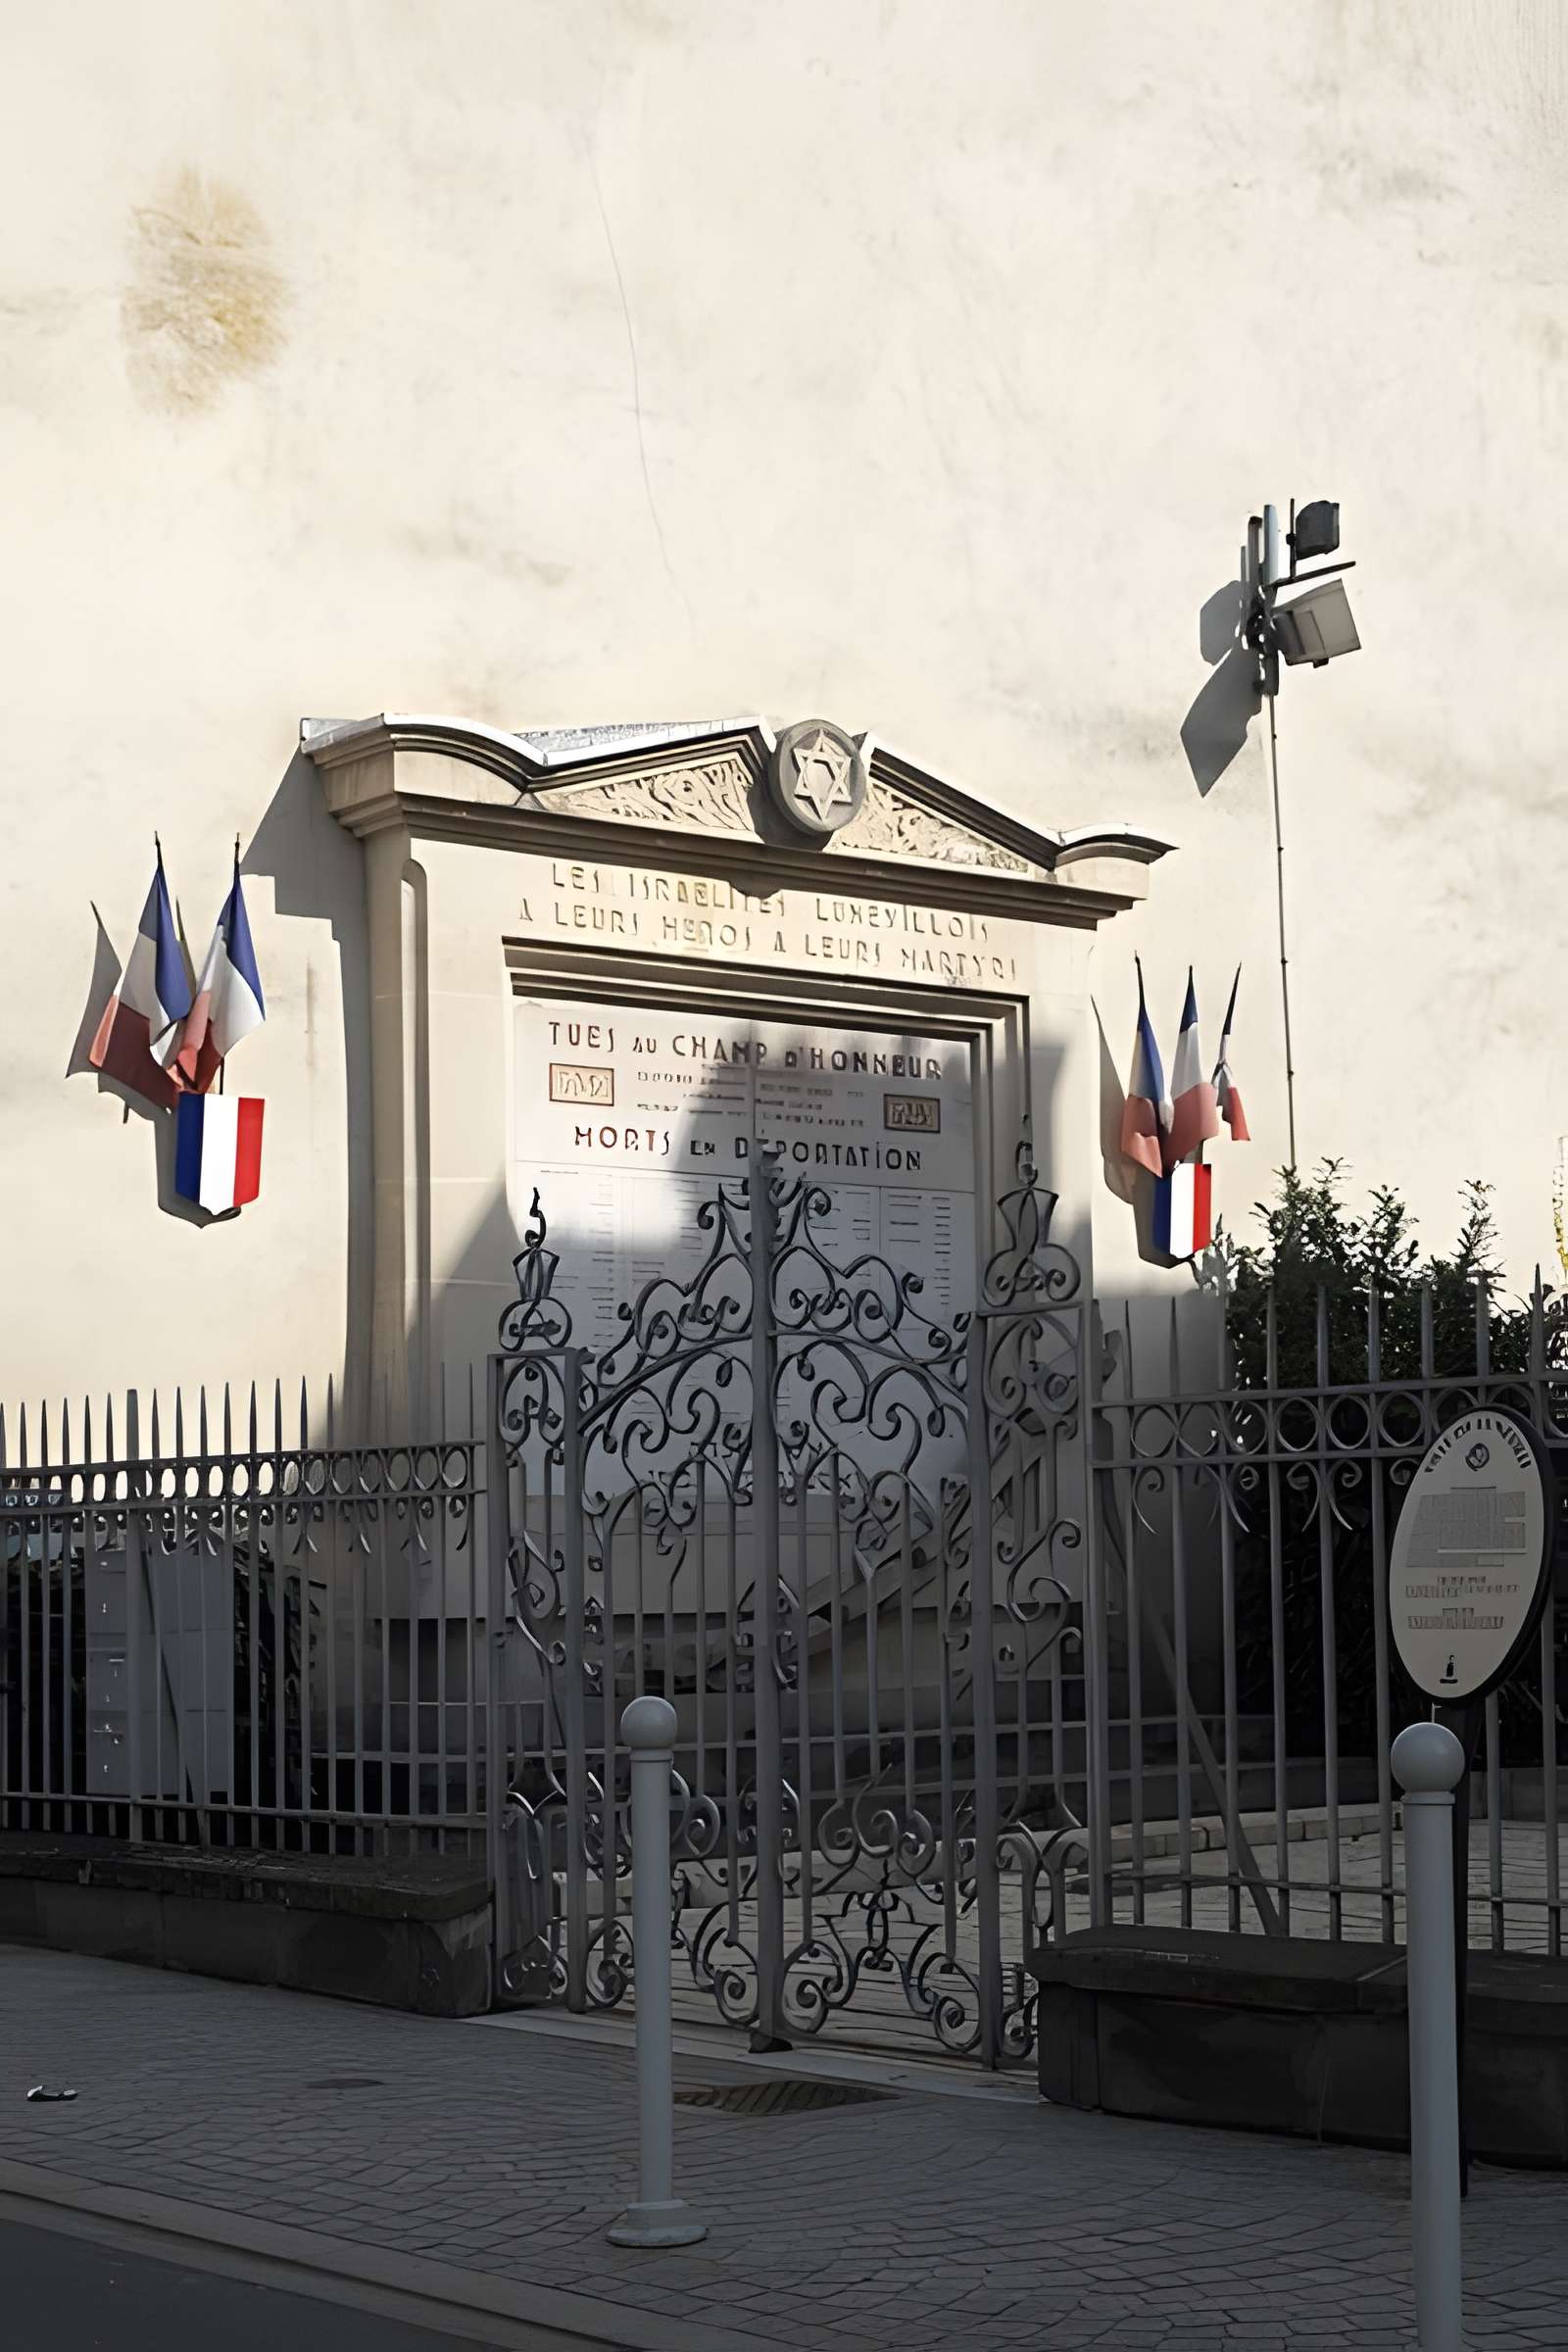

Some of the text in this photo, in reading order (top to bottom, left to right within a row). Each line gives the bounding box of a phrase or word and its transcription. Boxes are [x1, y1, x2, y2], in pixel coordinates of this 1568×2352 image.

[554, 902, 639, 936] LEURS
[632, 1036, 657, 1054] AU
[672, 1035, 768, 1064] CHAMP
[574, 1125, 670, 1155] MORTS
[735, 1136, 921, 1171] DPORTATION
